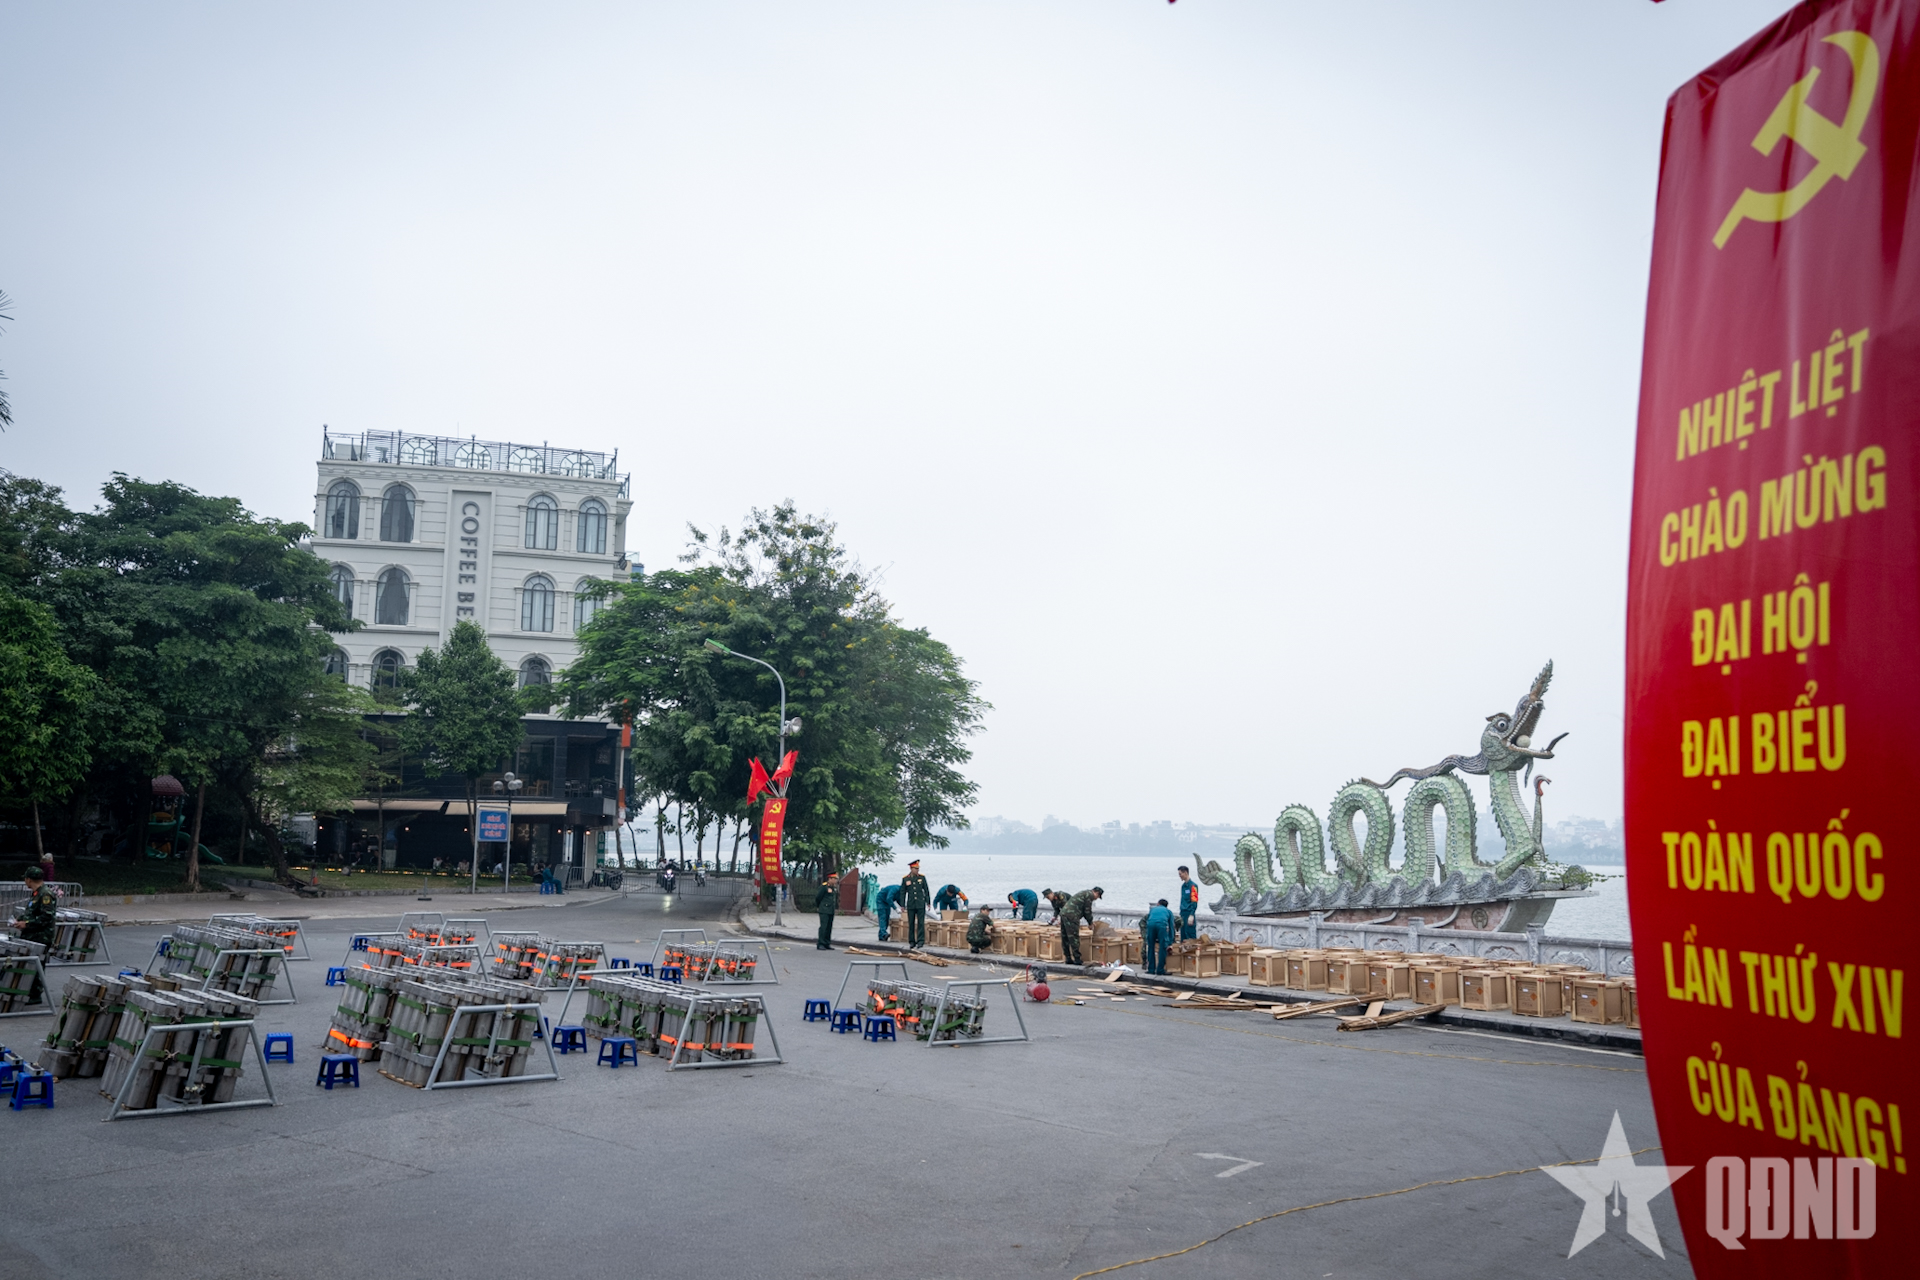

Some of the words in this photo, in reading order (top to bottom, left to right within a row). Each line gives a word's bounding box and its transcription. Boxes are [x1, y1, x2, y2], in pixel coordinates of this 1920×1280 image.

[1676, 367, 1782, 462] NHIỆT
[1789, 327, 1870, 420] LIỆT
[458, 500, 480, 585] COFFEE
[1658, 486, 1749, 568] CHÀO
[1758, 444, 1887, 541] MỪNG
[456, 591, 475, 623] BE
[1691, 598, 1751, 676] ĐẠI
[1762, 572, 1831, 665] HỘI
[1681, 714, 1741, 790] ĐẠI
[1751, 679, 1847, 775] BIỂU
[1661, 818, 1756, 894] TOÀN
[1765, 807, 1885, 903] QUỐC
[1662, 923, 1734, 1010] LẦN
[1739, 942, 1818, 1024] THỨ
[1827, 961, 1905, 1039] XIV
[1685, 1040, 1765, 1132] CỦA
[1767, 1059, 1908, 1175] ĐẢNG!
